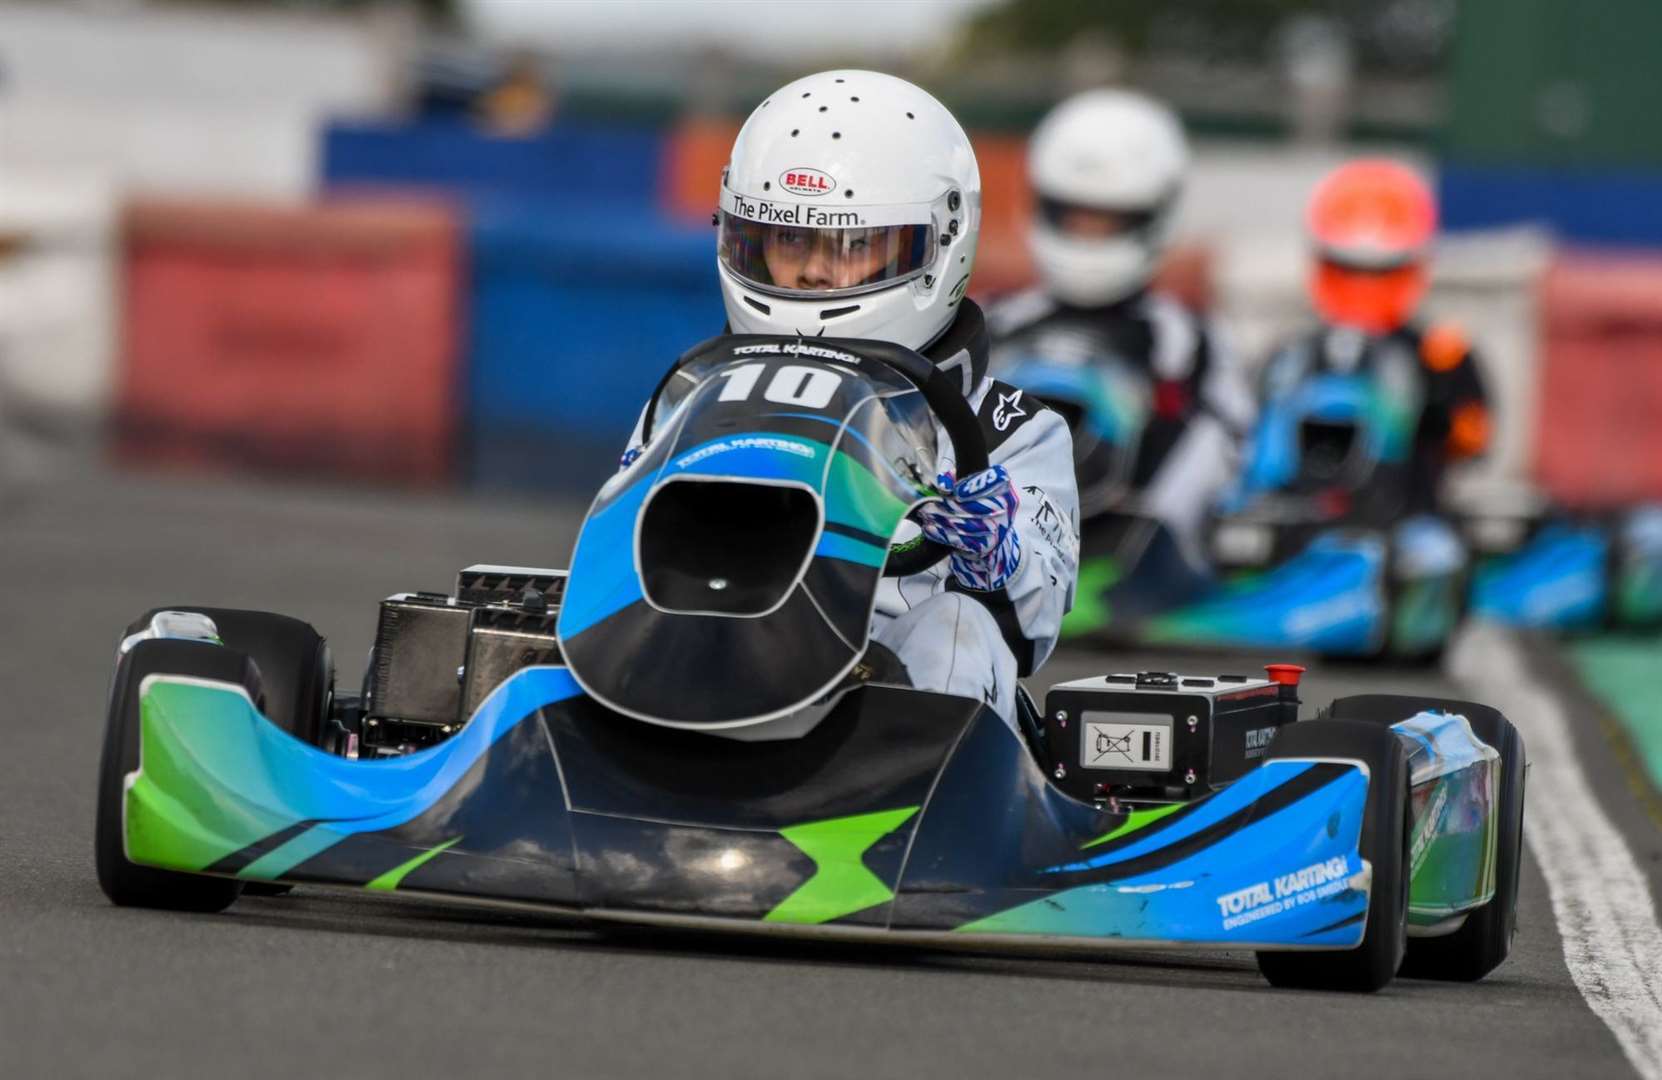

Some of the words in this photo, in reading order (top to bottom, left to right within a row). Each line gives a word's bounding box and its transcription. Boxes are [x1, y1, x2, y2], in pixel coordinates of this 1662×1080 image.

[785, 173, 828, 190] BELL
[733, 195, 755, 218] The
[758, 203, 801, 225] Pixel
[733, 344, 781, 355] TOTAL
[717, 363, 843, 409] 10
[1216, 882, 1274, 918] TOTAL
[1273, 855, 1350, 899] KARTING!
[1283, 898, 1297, 910] BY
